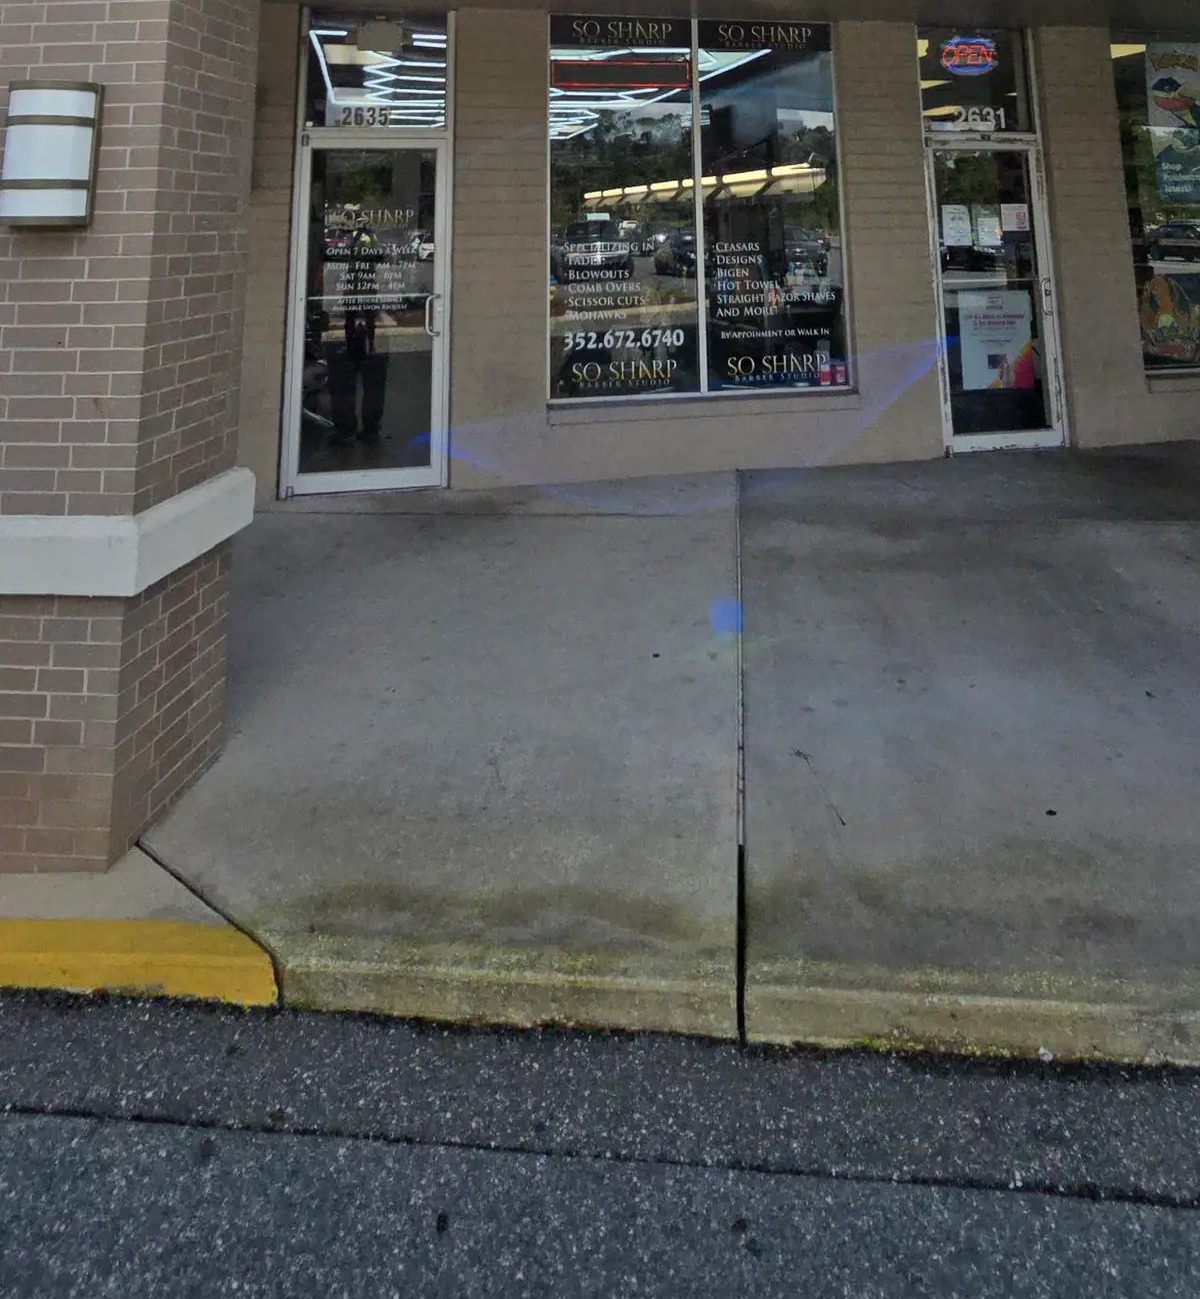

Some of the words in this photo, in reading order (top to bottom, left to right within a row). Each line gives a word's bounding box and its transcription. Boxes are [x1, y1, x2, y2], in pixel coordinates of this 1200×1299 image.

[572, 20, 601, 38] SO
[607, 19, 672, 39] SHARP
[718, 24, 744, 42] SO
[751, 25, 812, 43] SHARP
[942, 44, 994, 65] OPEN
[341, 106, 388, 126] 2635
[953, 105, 1006, 130] 2631
[360, 208, 415, 223] SHARP
[564, 242, 639, 252] SPECIALIZING
[642, 242, 655, 251] IN
[715, 242, 760, 252] CEASARS
[717, 254, 762, 265] DESIGNS
[568, 269, 630, 280] BLOWOUTS
[717, 268, 750, 279] BIGEN
[568, 283, 602, 293] COMB
[605, 282, 641, 293] OVERS
[717, 280, 741, 291] HOT
[568, 296, 614, 307] SCISSOR
[617, 295, 645, 306] CUTS
[717, 293, 765, 304] STRAIGHT
[768, 293, 801, 303] RAZOR
[803, 292, 836, 302] SHAVES
[716, 307, 740, 318] AND
[720, 330, 732, 339] BY
[797, 328, 819, 336] WALK
[820, 327, 830, 335] IN
[563, 328, 685, 351] 352.672.6740
[727, 355, 755, 375] SO
[762, 352, 827, 374] SHARP
[572, 362, 601, 382] SO
[609, 359, 677, 380] SHARP
